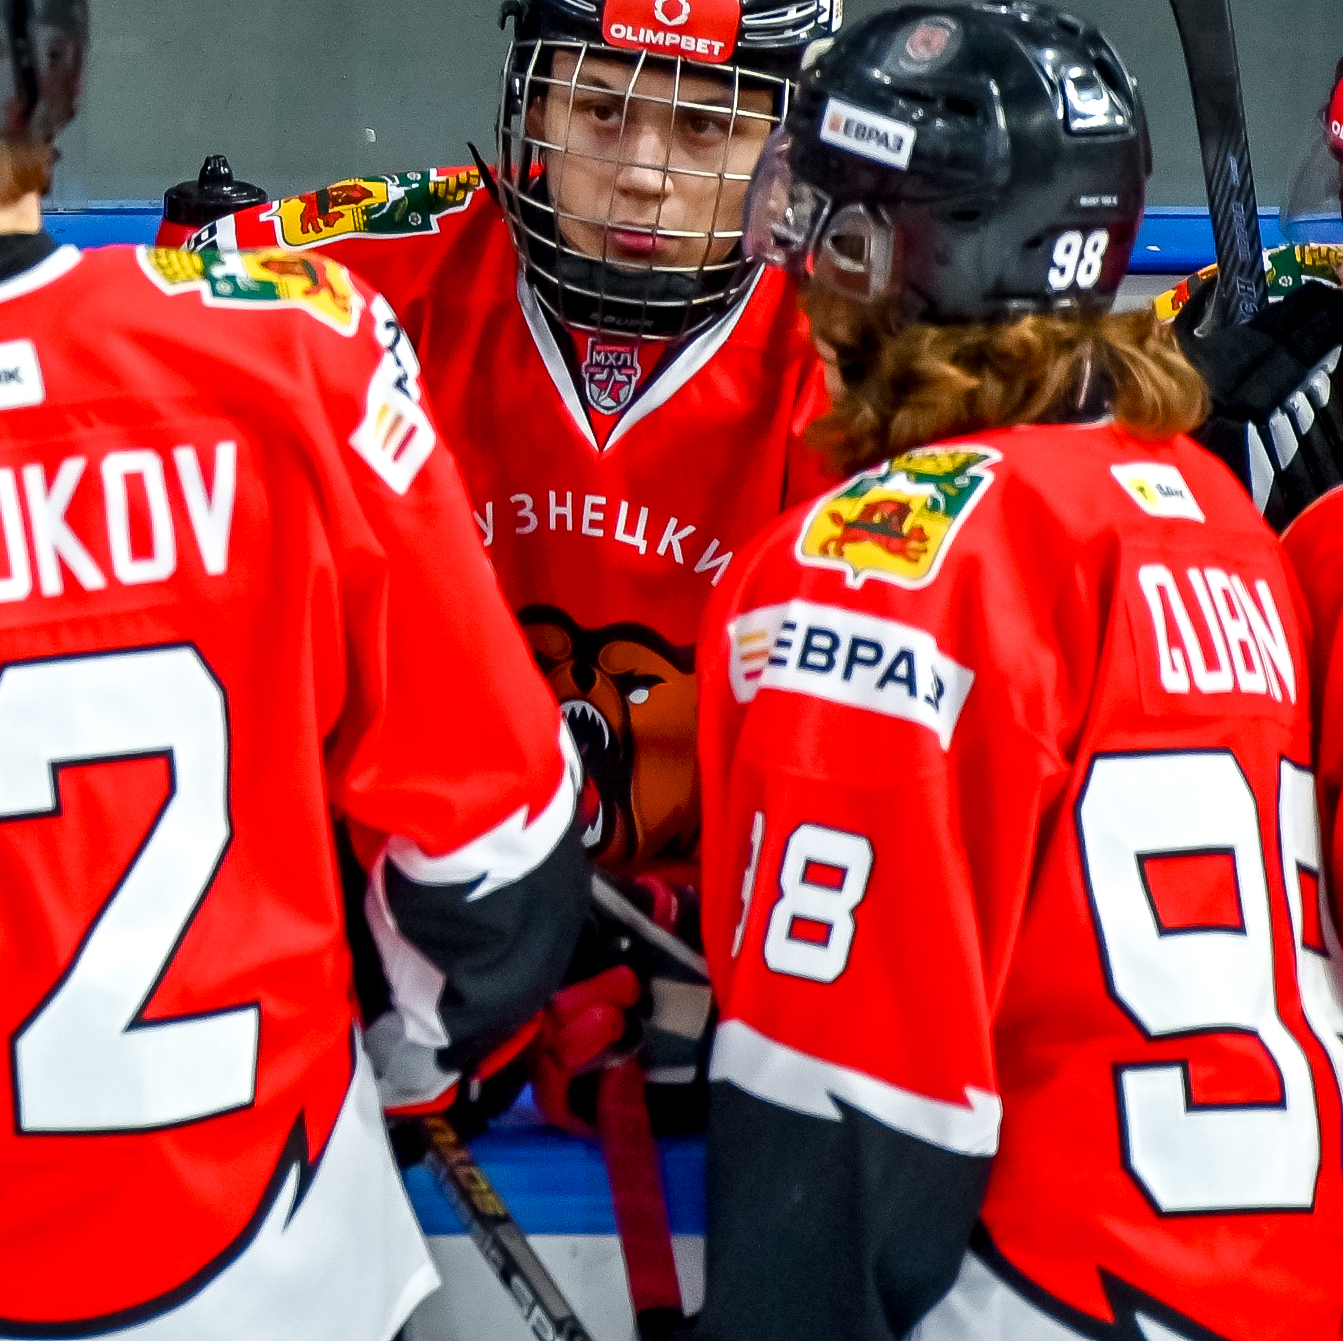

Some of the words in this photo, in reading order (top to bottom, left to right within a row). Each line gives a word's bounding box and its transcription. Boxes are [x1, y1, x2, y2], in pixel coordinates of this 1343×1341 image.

[610, 24, 725, 57] OLIMPBET
[1048, 228, 1109, 290] 98
[591, 350, 633, 366] МХЛ
[473, 489, 734, 587] УЗНЕЦКИ
